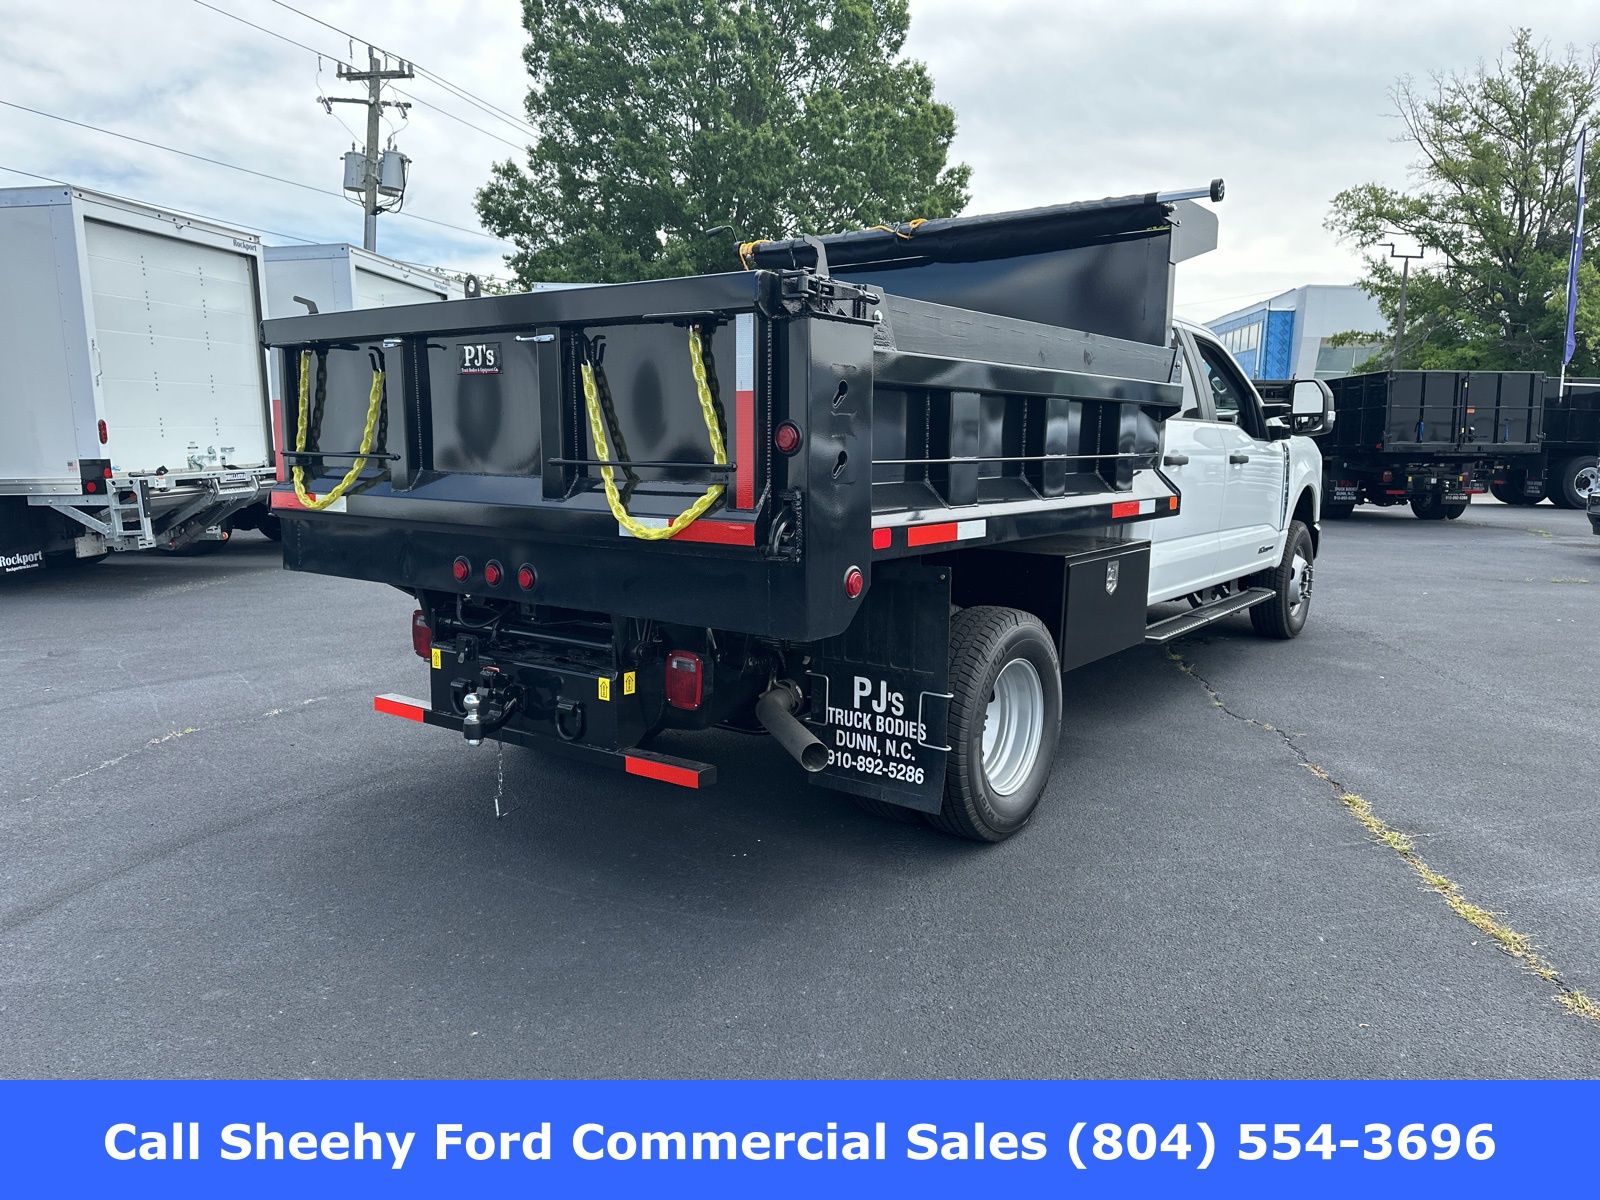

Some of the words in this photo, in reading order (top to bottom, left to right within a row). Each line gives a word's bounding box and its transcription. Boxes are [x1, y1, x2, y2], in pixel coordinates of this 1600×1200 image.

[463, 344, 495, 367] PJ's
[0, 550, 43, 567] Rockport
[853, 675, 905, 717] PJ's
[828, 706, 872, 731] TRUCK
[875, 715, 927, 741] BODIES
[835, 729, 881, 757] DUNN,
[885, 738, 916, 761] N.C.
[827, 749, 925, 785] 910-892-5286
